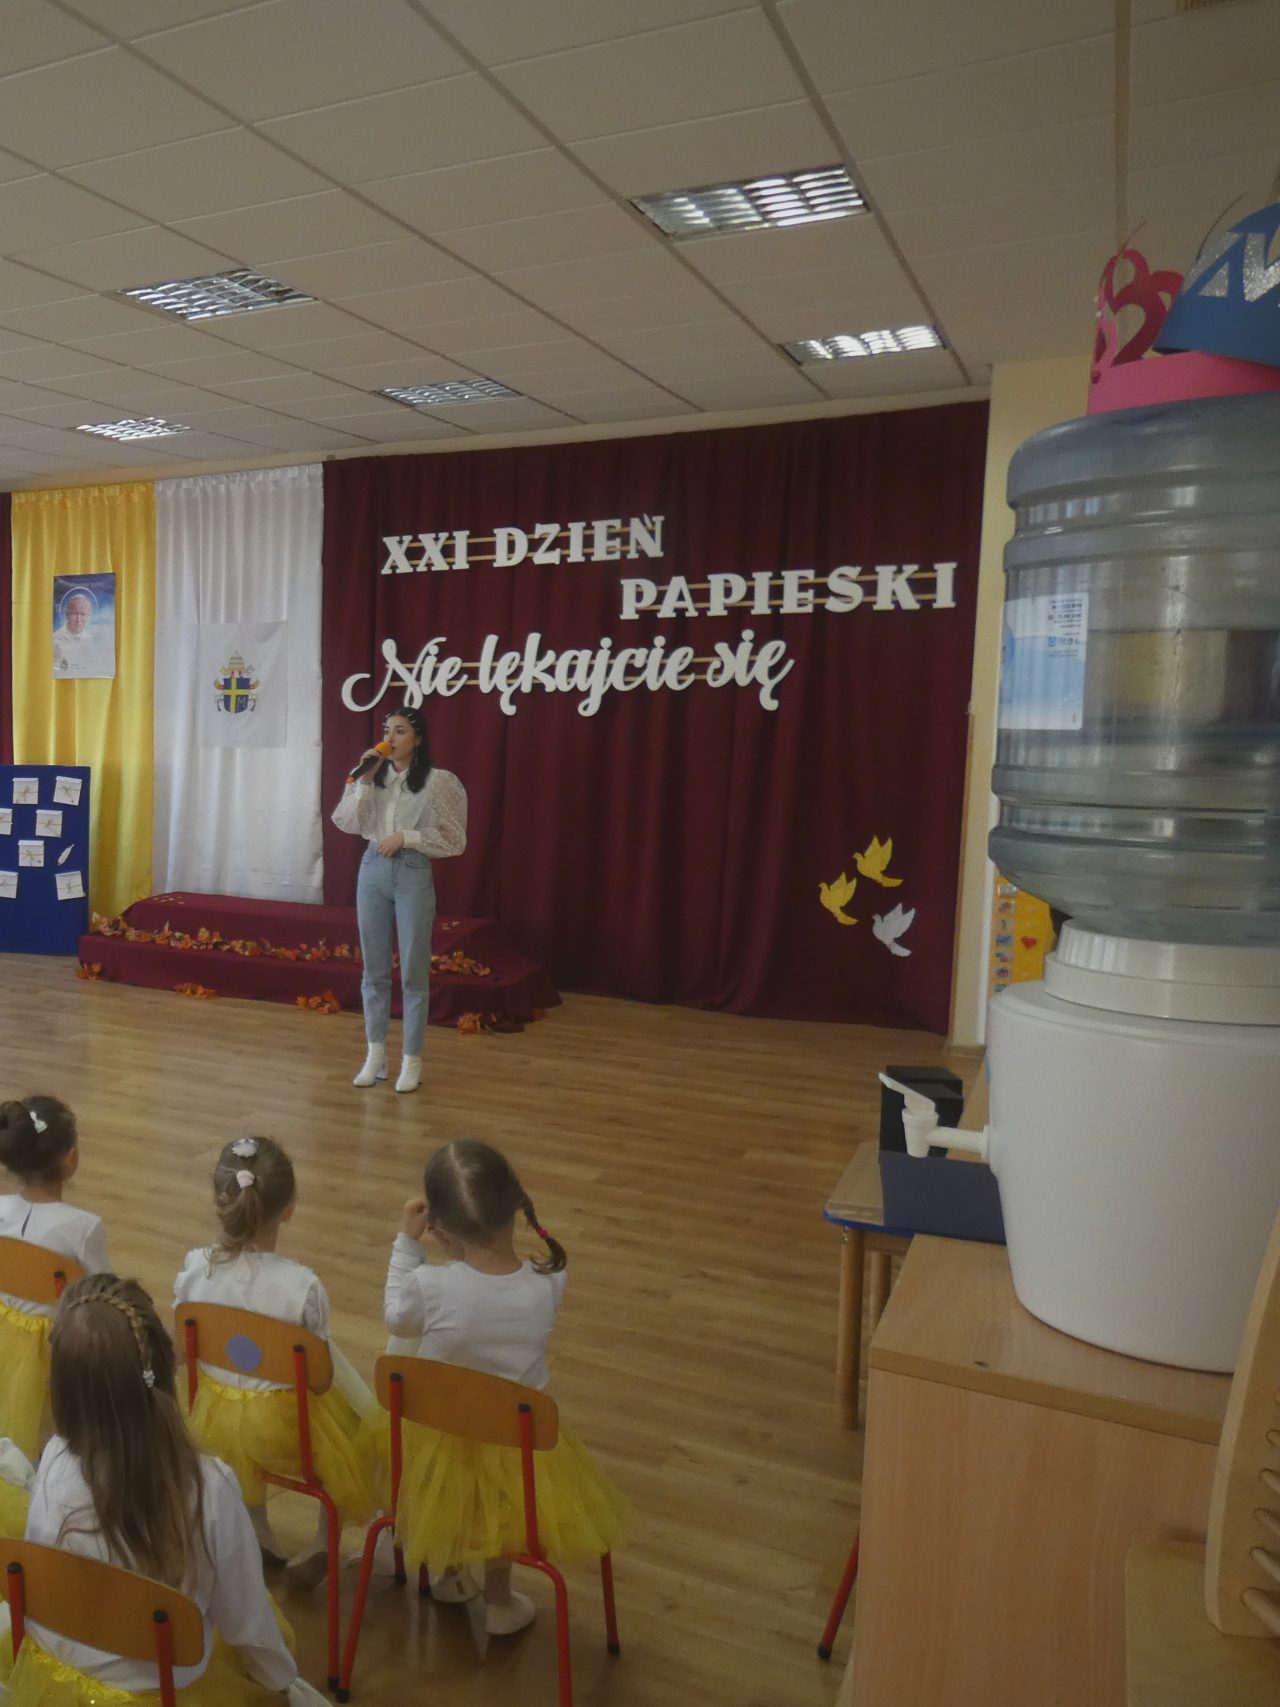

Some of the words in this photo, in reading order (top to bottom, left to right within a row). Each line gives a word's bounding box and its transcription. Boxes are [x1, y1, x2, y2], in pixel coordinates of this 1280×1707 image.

[381, 531, 470, 574] XXI
[620, 562, 958, 620] PAPIESKI
[341, 637, 468, 712] Nie
[478, 632, 696, 716] lękajcie
[705, 629, 795, 712] się
